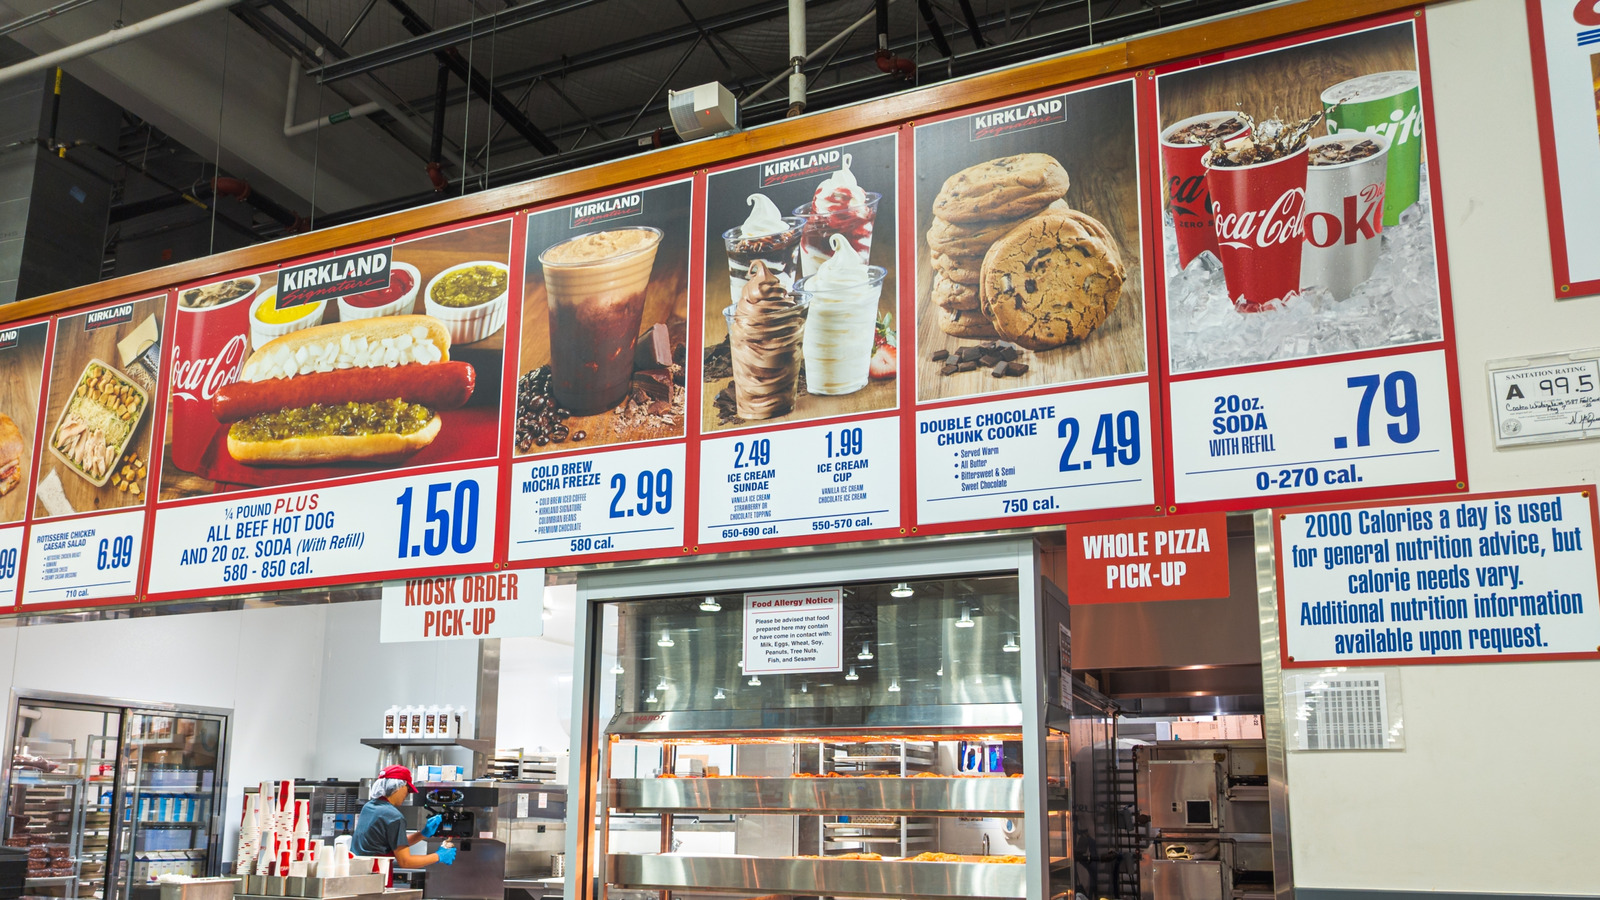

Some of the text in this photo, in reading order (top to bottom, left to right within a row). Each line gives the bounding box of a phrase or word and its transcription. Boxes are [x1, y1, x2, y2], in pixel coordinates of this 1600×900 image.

[975, 99, 1062, 130] KIRKLAND
[975, 115, 1063, 140] Signature
[764, 150, 840, 177] KIRKLAND
[764, 165, 840, 186] Signature
[574, 194, 640, 218] KIRKLAND
[574, 208, 640, 227] Signature
[283, 253, 387, 291] KIRKLAND
[281, 277, 385, 307] Signature
[88, 305, 132, 323] KIRKLAND
[1505, 366, 1586, 380] SANITATION RATING
[1506, 384, 1525, 400] A
[920, 406, 1056, 434] DOUBLE CHOCOLATE
[1333, 370, 1421, 449] .79
[937, 423, 1037, 447] CHUNK COOKIE
[1212, 412, 1268, 435] SODA
[825, 427, 863, 458] 1.99
[1057, 409, 1141, 473] 2.49
[1209, 434, 1276, 457] WITH REFILL
[734, 438, 771, 469] 2.49
[960, 447, 999, 459] Served Warm
[970, 459, 987, 468] Butter
[531, 460, 593, 480] COLD BREW
[727, 469, 776, 483] ICE CREAM
[817, 459, 869, 473] ICE CREAM
[833, 472, 852, 483] CUP
[961, 466, 1015, 481] Bittersweet & Semi
[1256, 464, 1363, 491] 0-270 cal.
[522, 473, 601, 494] MOCHA FREEZE
[609, 468, 673, 519] 2.99
[733, 481, 769, 493] SUNDAE
[821, 486, 839, 495] VANILLA
[848, 484, 864, 492] CREAM
[961, 479, 1007, 492] Sweet Chocolate
[236, 502, 272, 519] POUND
[274, 493, 320, 515] PLUS
[731, 496, 748, 504] VANILLA
[756, 493, 771, 501] CREAM
[734, 503, 761, 512] STRAWBERRY
[818, 495, 843, 504] CHOCOLATE
[851, 492, 867, 501] CREAM
[1002, 496, 1060, 513] 750 cal.
[207, 511, 335, 542] ALL BEEF HOT DOG
[396, 479, 479, 559] 1.50
[730, 510, 771, 520] CHOCOLATE TOPPING
[812, 516, 873, 531] 550-570 cal.
[1305, 496, 1563, 538] 2000 Calories a day is used
[37, 529, 96, 543] ROTISSERIE CHICKEN
[722, 525, 779, 539] 650-690 cal.
[43, 538, 86, 551] CAESAR SALAD
[97, 535, 133, 570] 6.99
[180, 532, 365, 566] AND 20 oz. SODA (With Refill)
[570, 536, 614, 552] 580 cal.
[1082, 528, 1211, 560] WHOLE PIZZA
[1291, 527, 1583, 570] for general nutrition advice, but
[223, 557, 313, 582] 580 850 cal.
[1106, 561, 1187, 589] PICK-UP
[1348, 564, 1524, 594] calorie needs vary.
[66, 589, 89, 598] 710 cal.
[405, 573, 518, 607] KIOSK ORDER
[752, 597, 834, 608] Food Allergy Notice
[1300, 589, 1584, 627] Additional nutrition information
[423, 607, 496, 637] PICK-UP
[1334, 623, 1549, 655] available upon request.
